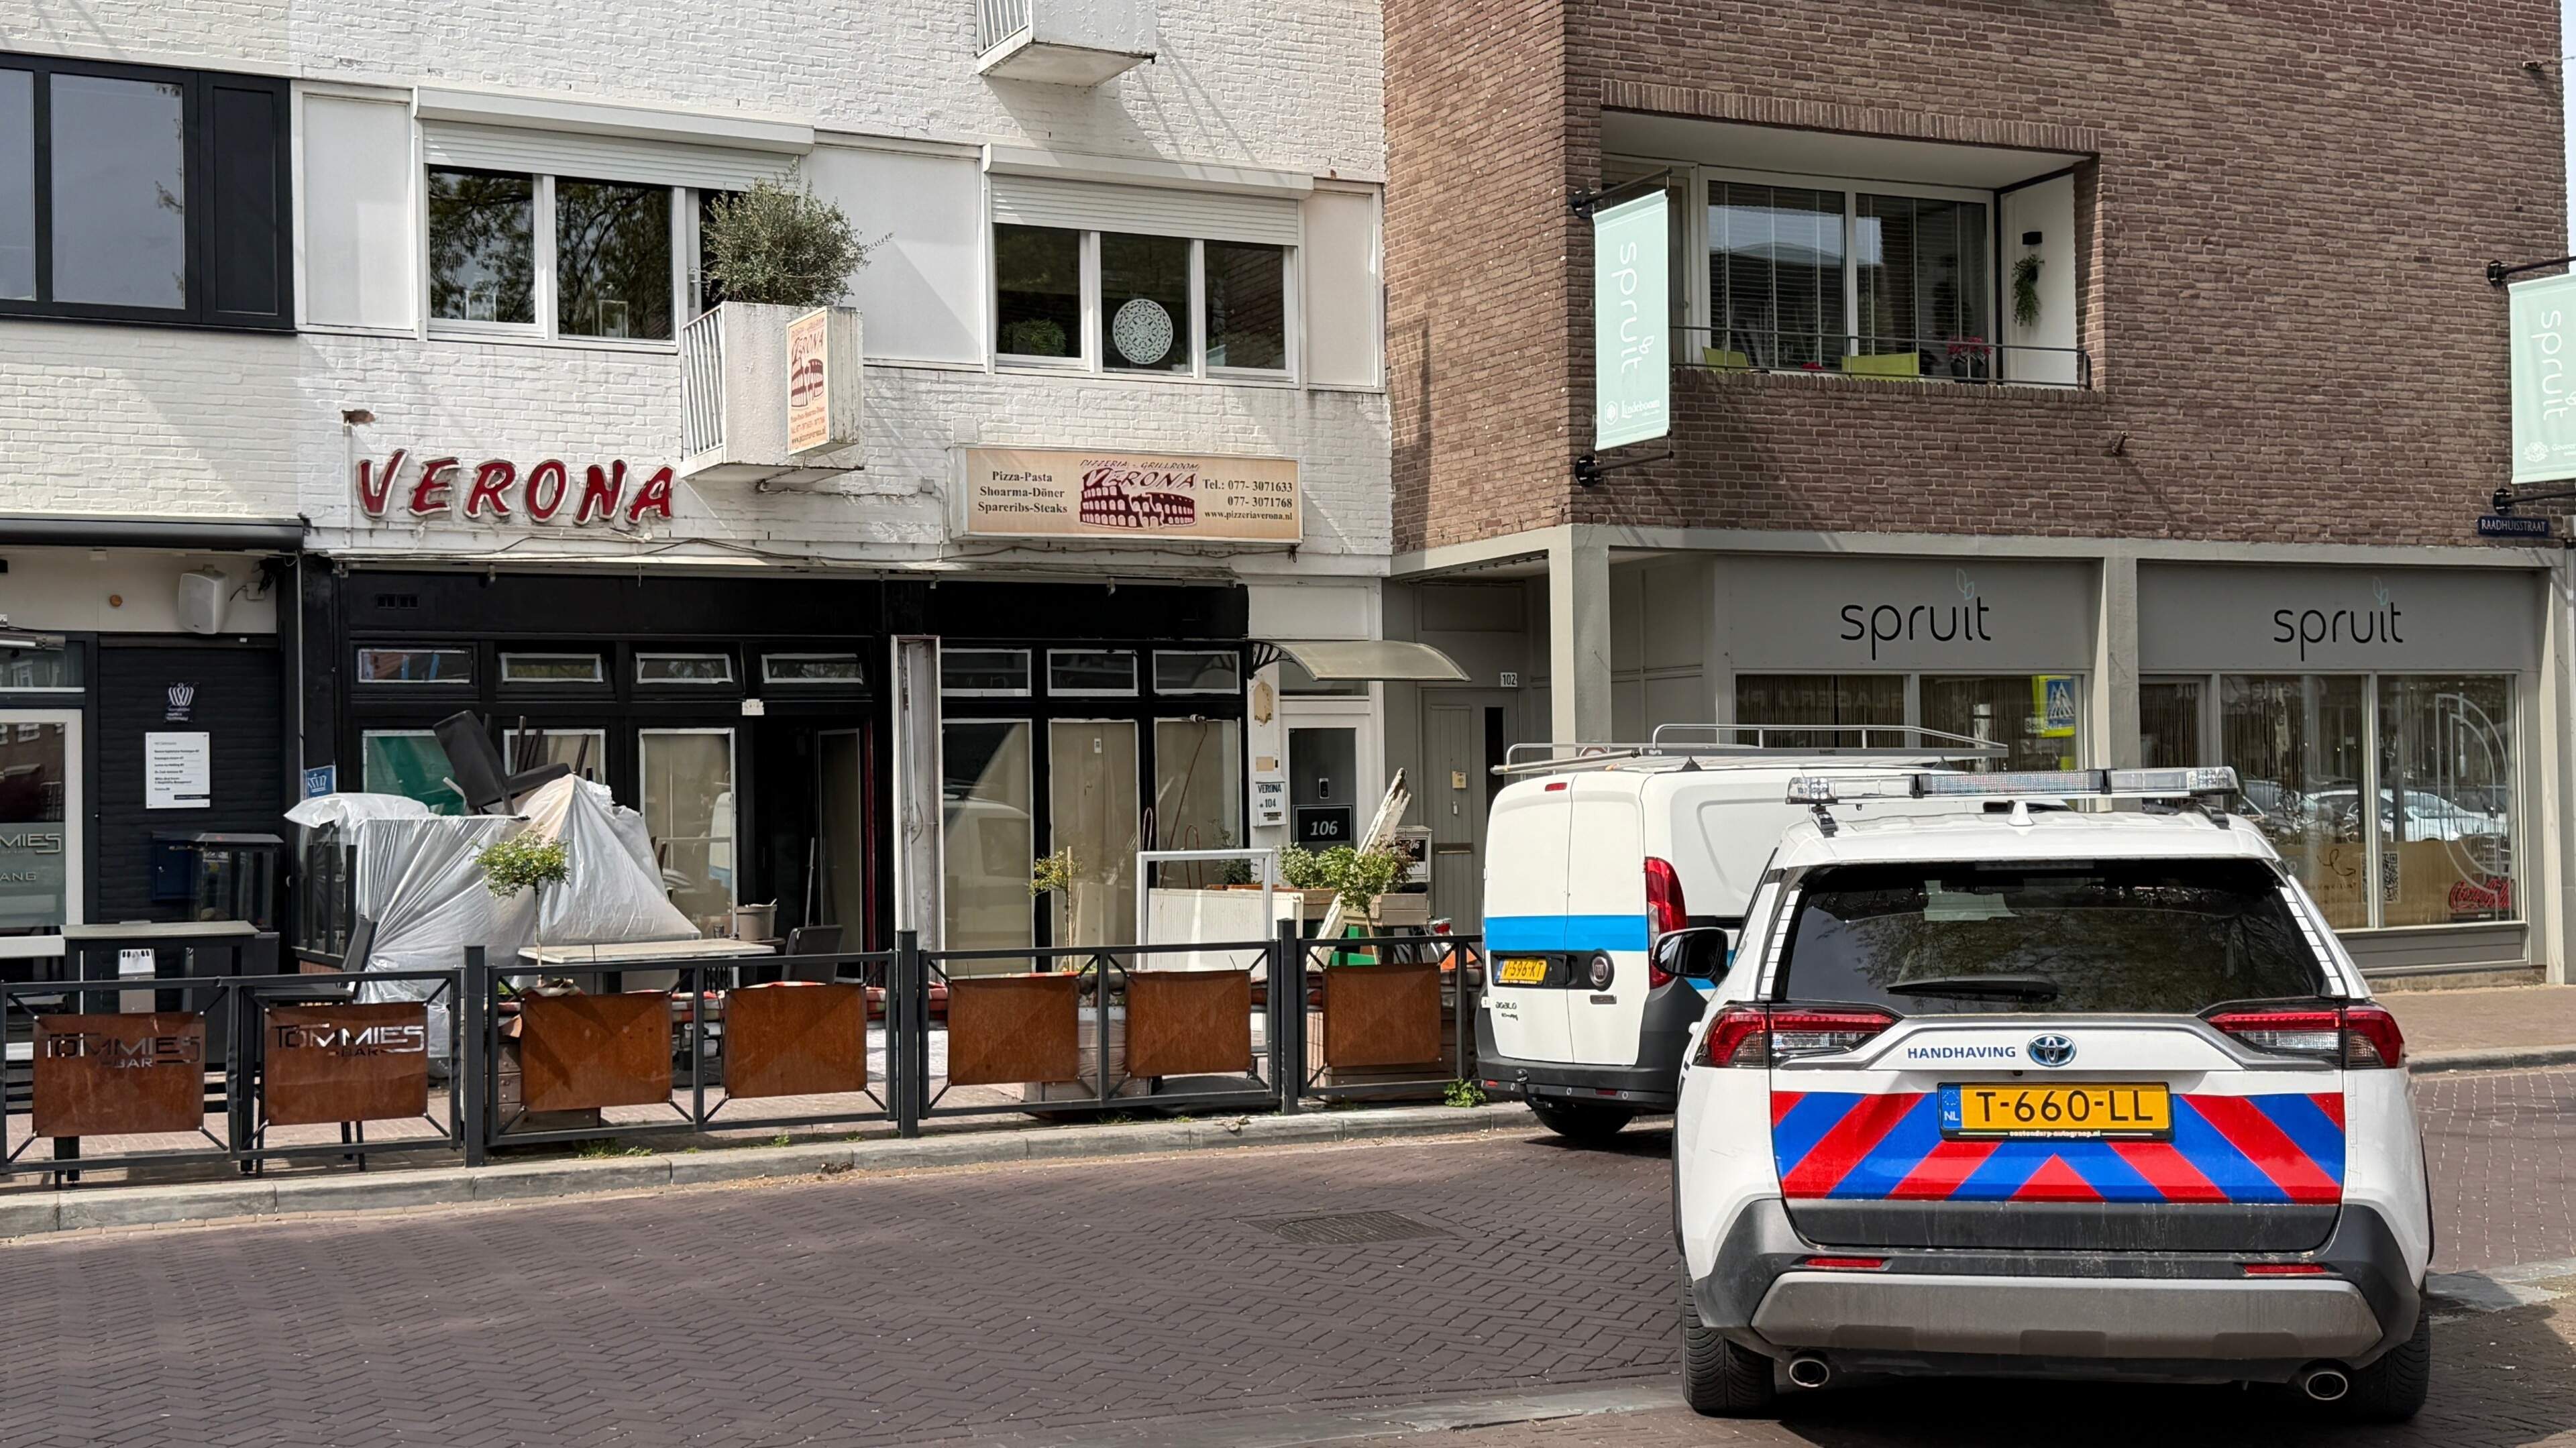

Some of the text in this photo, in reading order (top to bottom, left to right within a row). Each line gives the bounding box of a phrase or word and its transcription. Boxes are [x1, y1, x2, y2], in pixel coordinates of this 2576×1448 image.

[1611, 241, 1643, 374] spruit
[2530, 309, 2565, 421] spruit
[1079, 459, 1128, 468] PIZZERIA
[1140, 461, 1199, 470] GRILLROOM
[991, 471, 1053, 482] Pizza-Pasta
[1085, 467, 1197, 490] VERONA
[355, 449, 676, 526] VERONA
[979, 486, 1065, 498] Shoarma-Döner
[1252, 482, 1293, 493] 3071633
[977, 501, 1068, 514] Spareribs-Steaks
[1252, 497, 1293, 508] 3071768
[1204, 510, 1293, 521] www.pizzeriaverona.nl
[2481, 519, 2546, 532] RAADHUISSTRAAT
[1840, 596, 1992, 661] spruit
[2273, 602, 2404, 662] spruit
[1502, 673, 1516, 685] 102
[1257, 783, 1282, 794] VERONA
[1265, 797, 1277, 808] 104
[1309, 820, 1338, 836] 106
[271, 1023, 425, 1054] TOMMIES
[43, 1032, 201, 1064] TOMMIES
[1907, 1046, 2017, 1059] HANDHAVING
[1976, 1089, 2153, 1122] T-660-LL
[1944, 1111, 1960, 1121] NL
